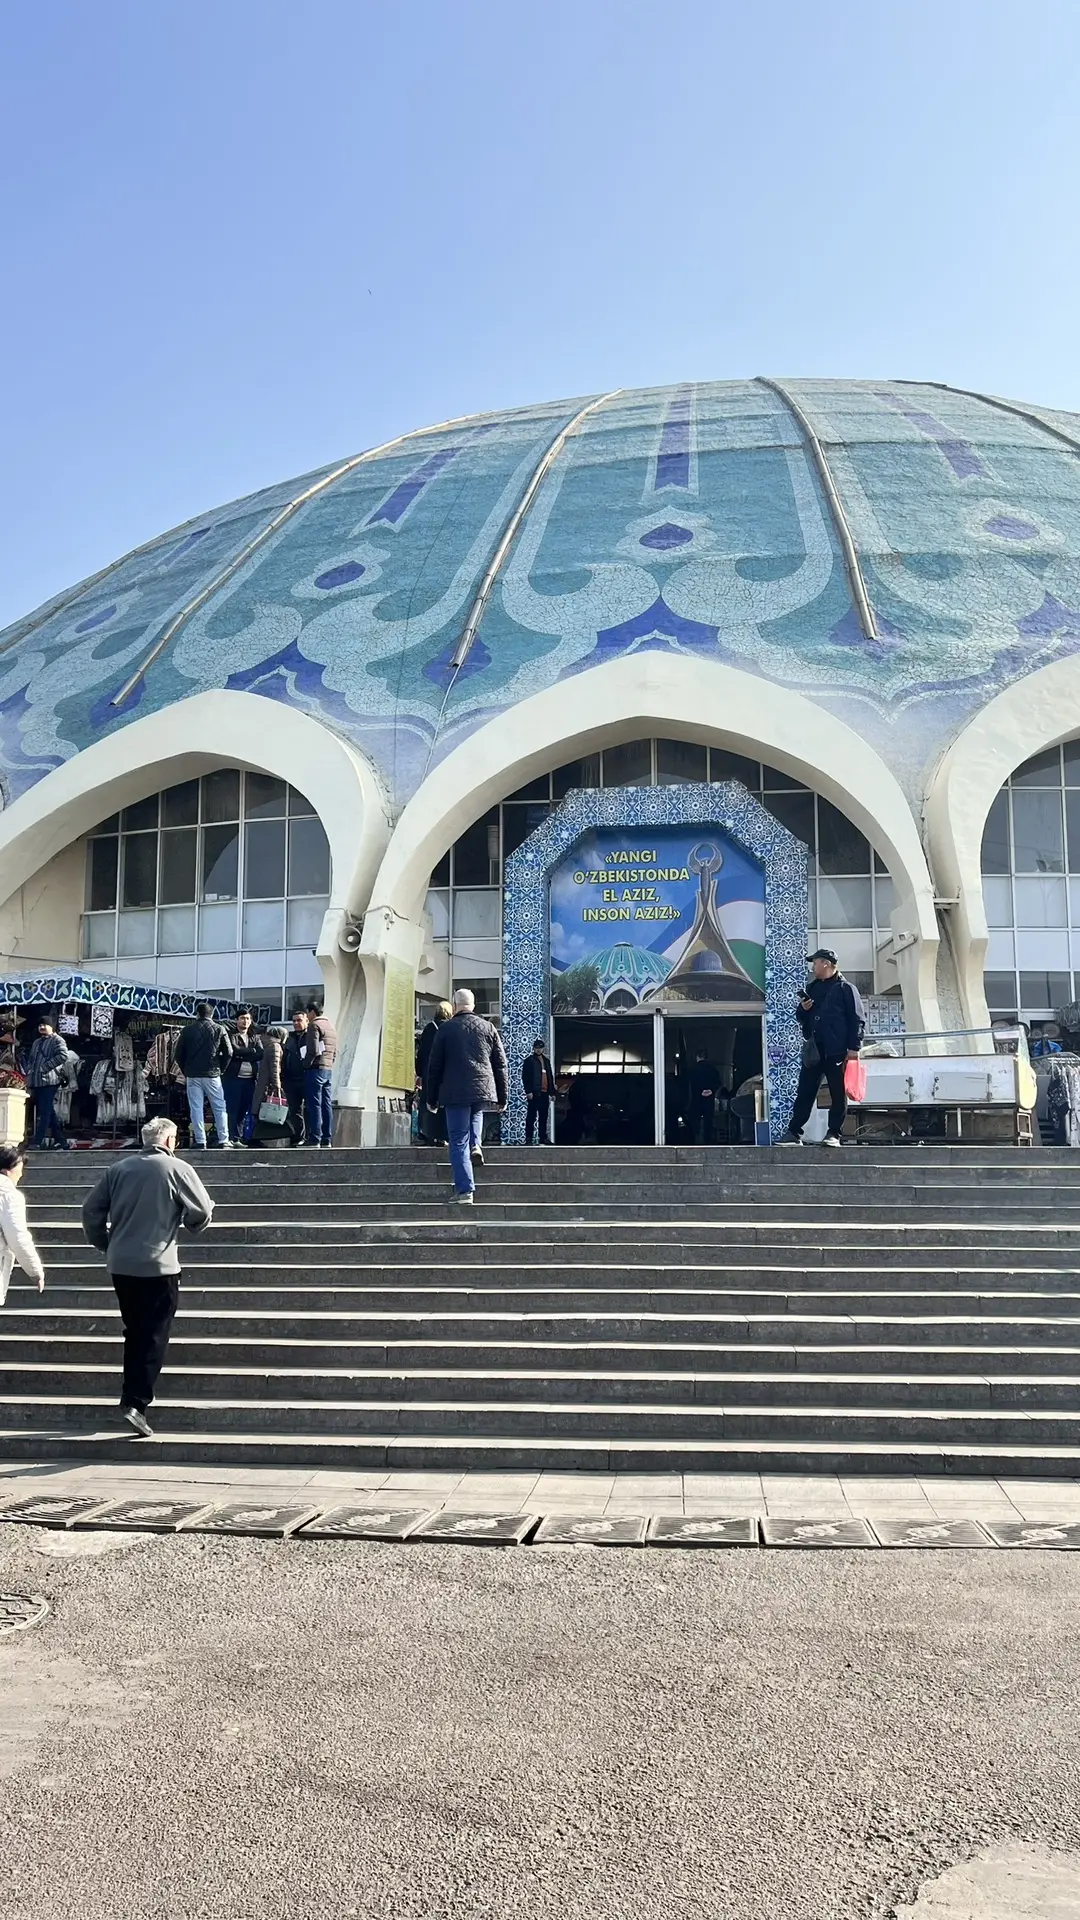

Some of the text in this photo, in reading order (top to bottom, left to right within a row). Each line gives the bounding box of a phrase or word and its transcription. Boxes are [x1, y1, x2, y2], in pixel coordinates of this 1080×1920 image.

[605, 850, 656, 863] «YANGI
[603, 888, 660, 903] EL AZIZ,
[583, 907, 681, 922] INSON AZIZ!»
